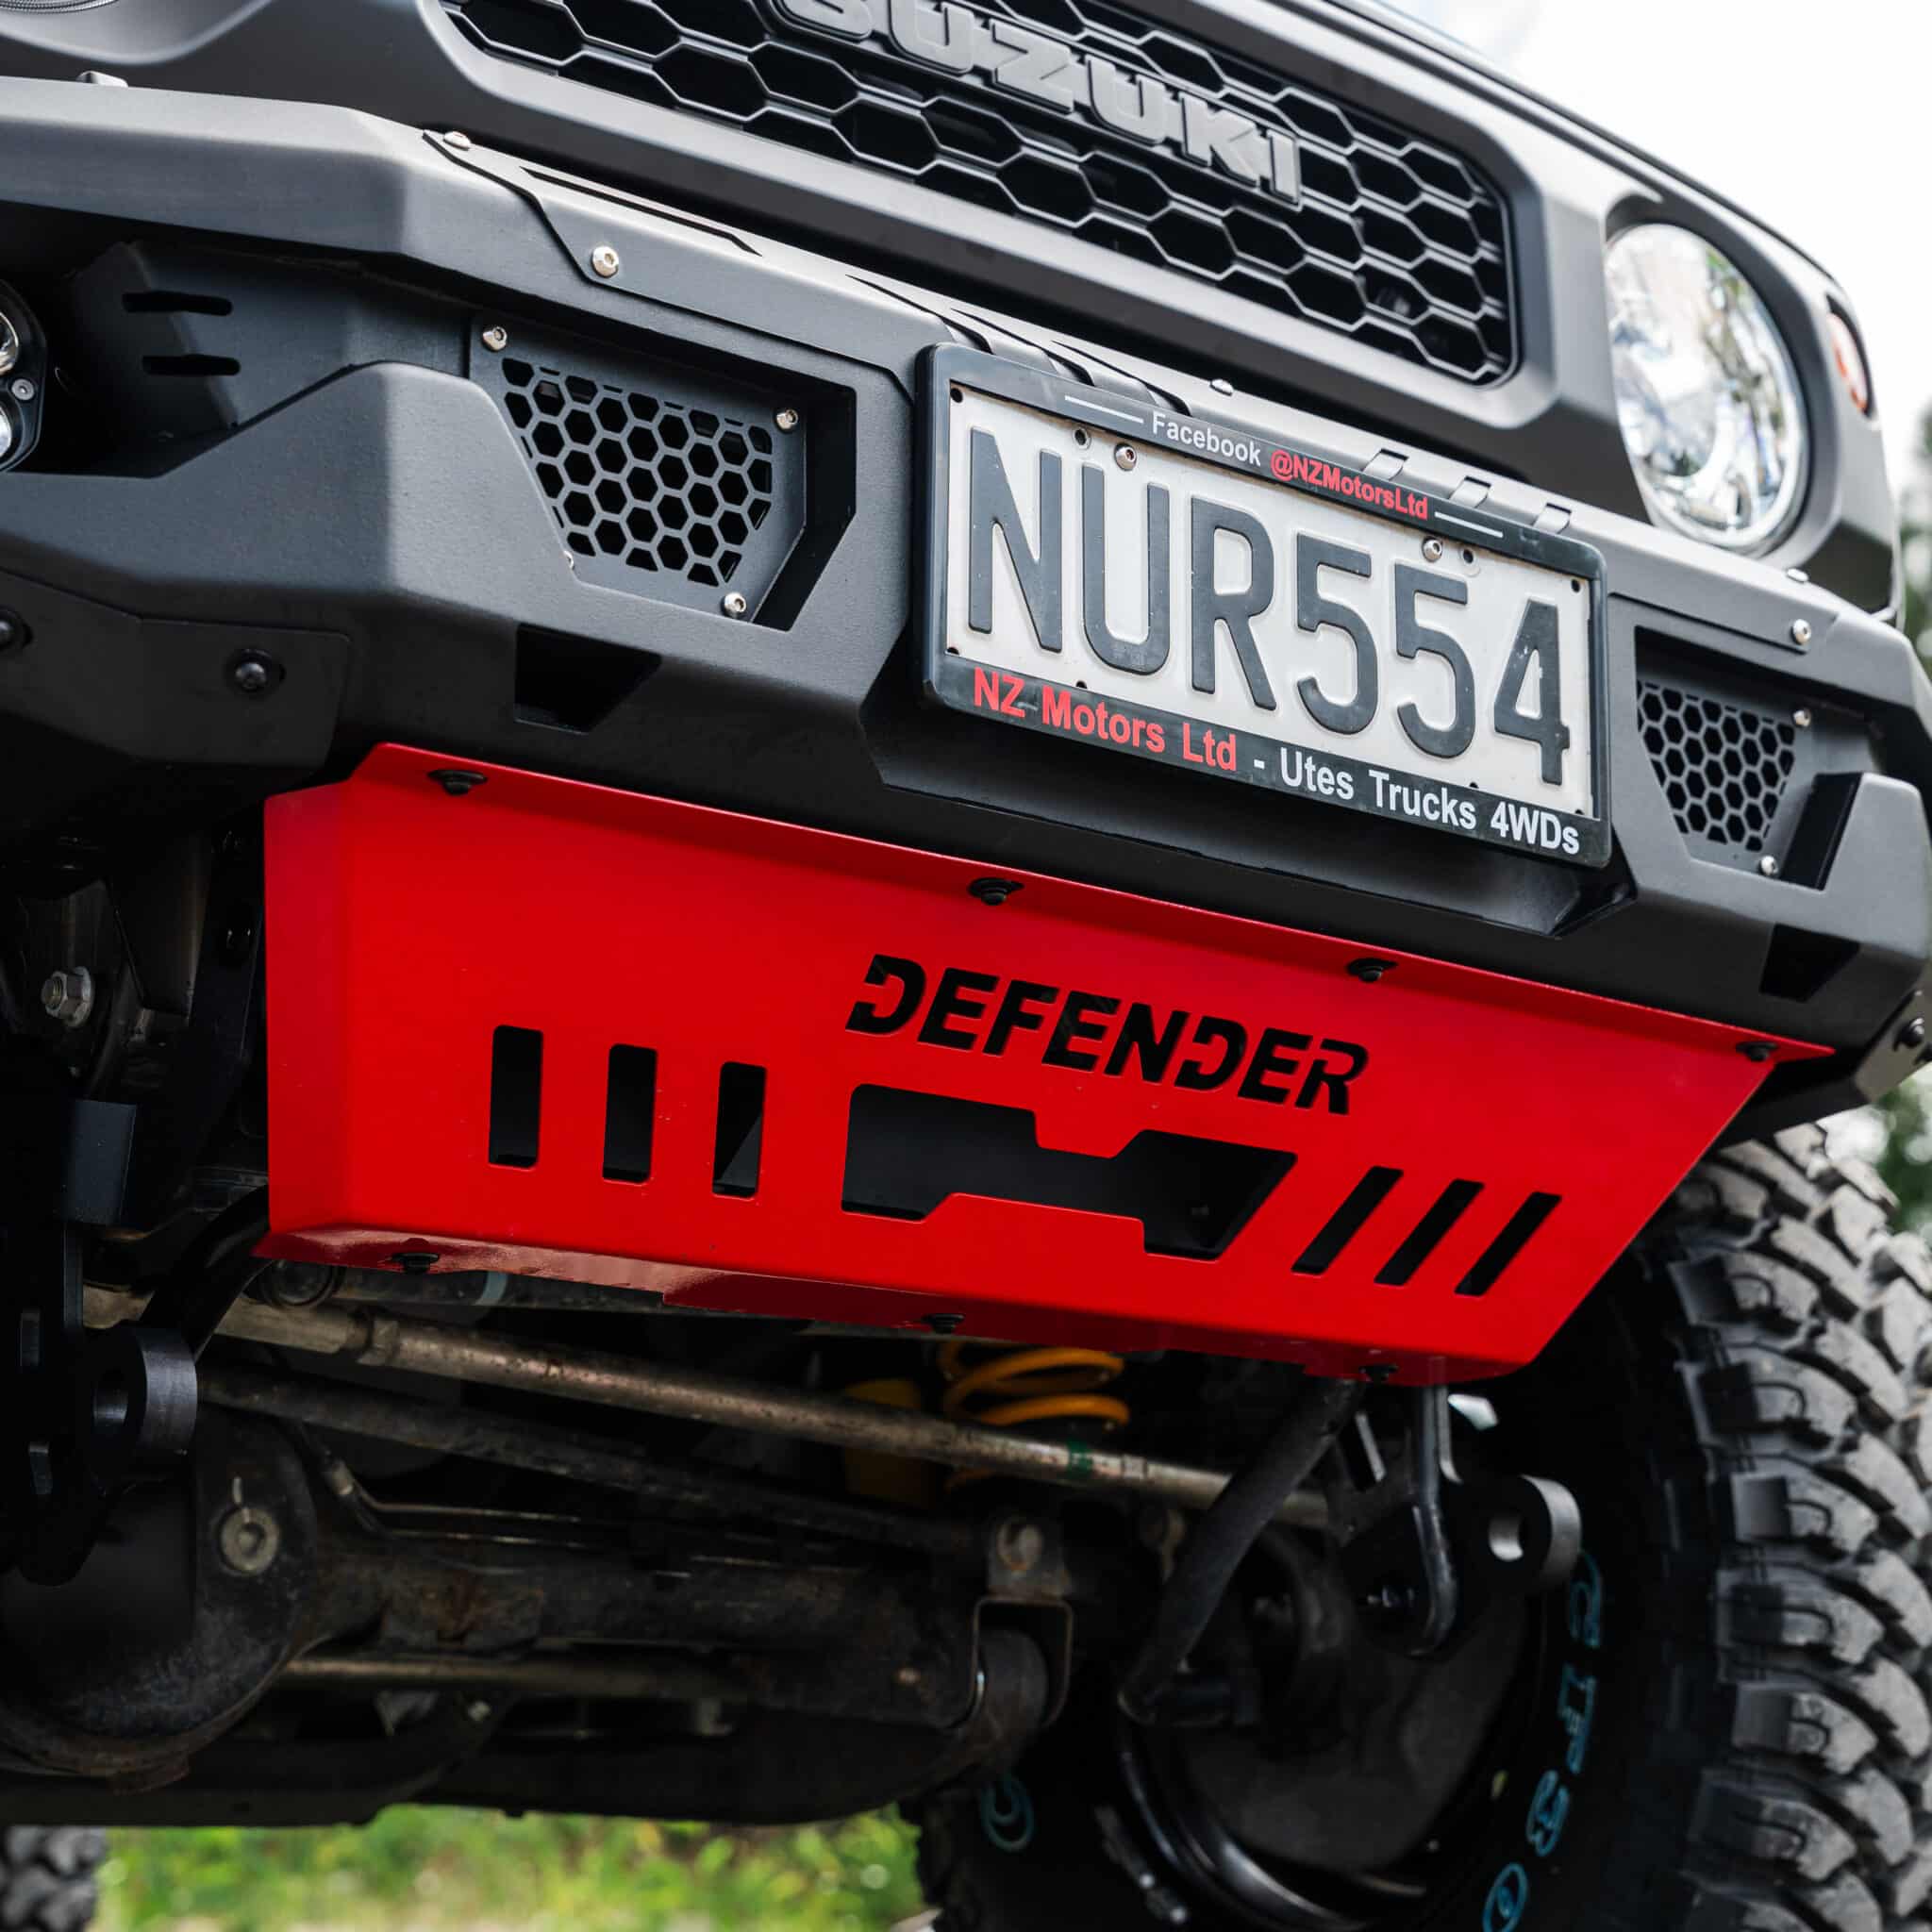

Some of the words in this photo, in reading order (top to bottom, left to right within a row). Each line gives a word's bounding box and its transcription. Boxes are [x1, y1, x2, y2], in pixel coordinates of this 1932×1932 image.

[1152, 412, 1261, 466] Facebook
[1270, 450, 1427, 520] @NZMotorsLtd
[968, 426, 1571, 786] NUR554
[974, 667, 1025, 718] NZ
[1041, 686, 1165, 753] Motors
[1182, 722, 1237, 772] Ltd
[1280, 746, 1354, 801] Utes
[1369, 770, 1477, 830] Trucks
[1491, 801, 1580, 855] 4WDs
[846, 954, 1368, 1116] DEFENDER
